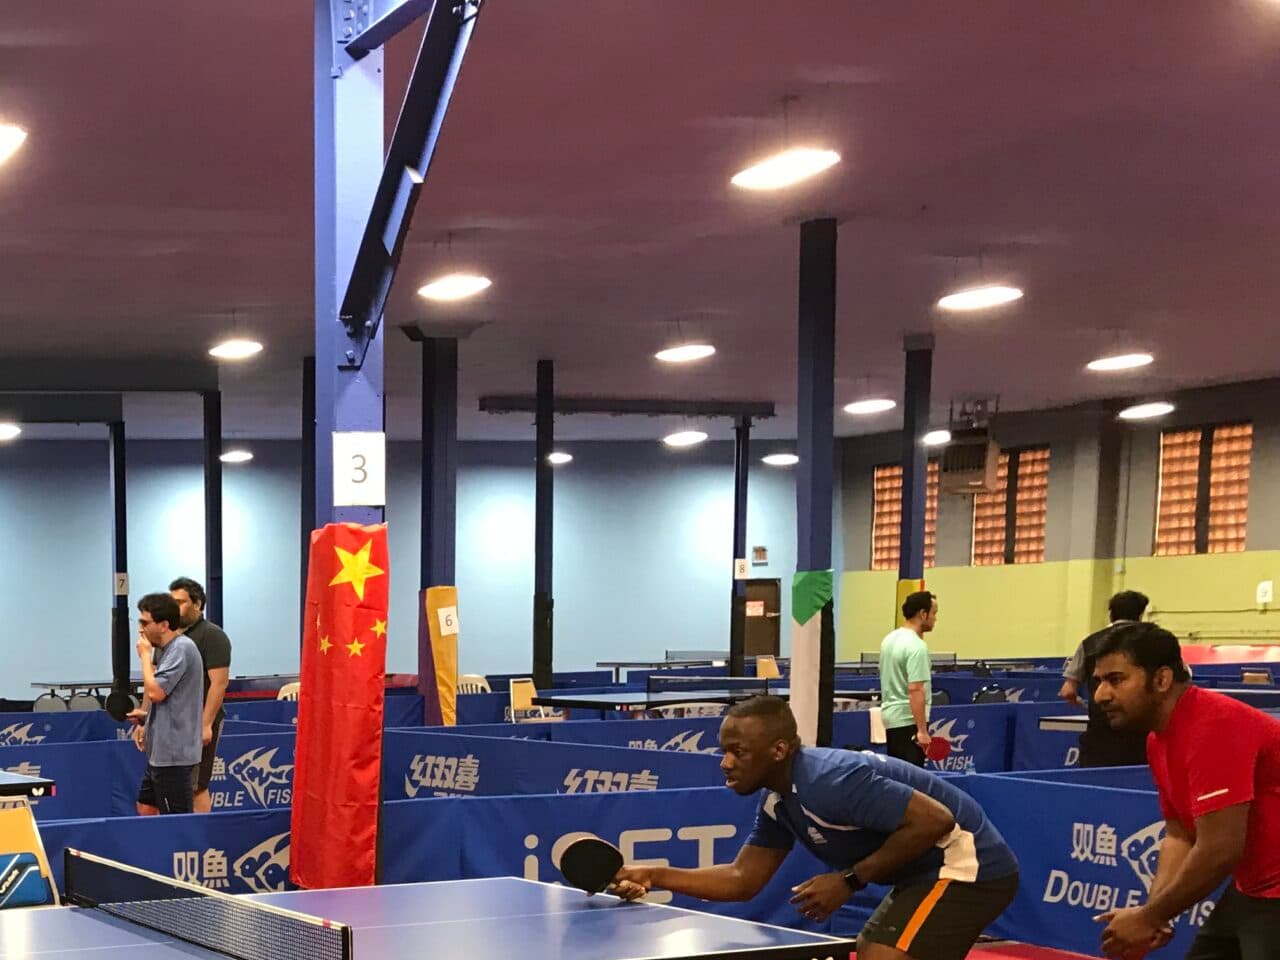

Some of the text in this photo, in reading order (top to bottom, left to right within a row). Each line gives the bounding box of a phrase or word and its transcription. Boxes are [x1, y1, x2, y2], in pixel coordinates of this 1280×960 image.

[351, 453, 368, 484] 3
[739, 564, 745, 574] 8
[119, 578, 125, 589] 7
[445, 614, 453, 627] 6
[266, 788, 292, 805] FIS
[1071, 822, 1118, 867] 双魚
[173, 848, 230, 889] 双魚
